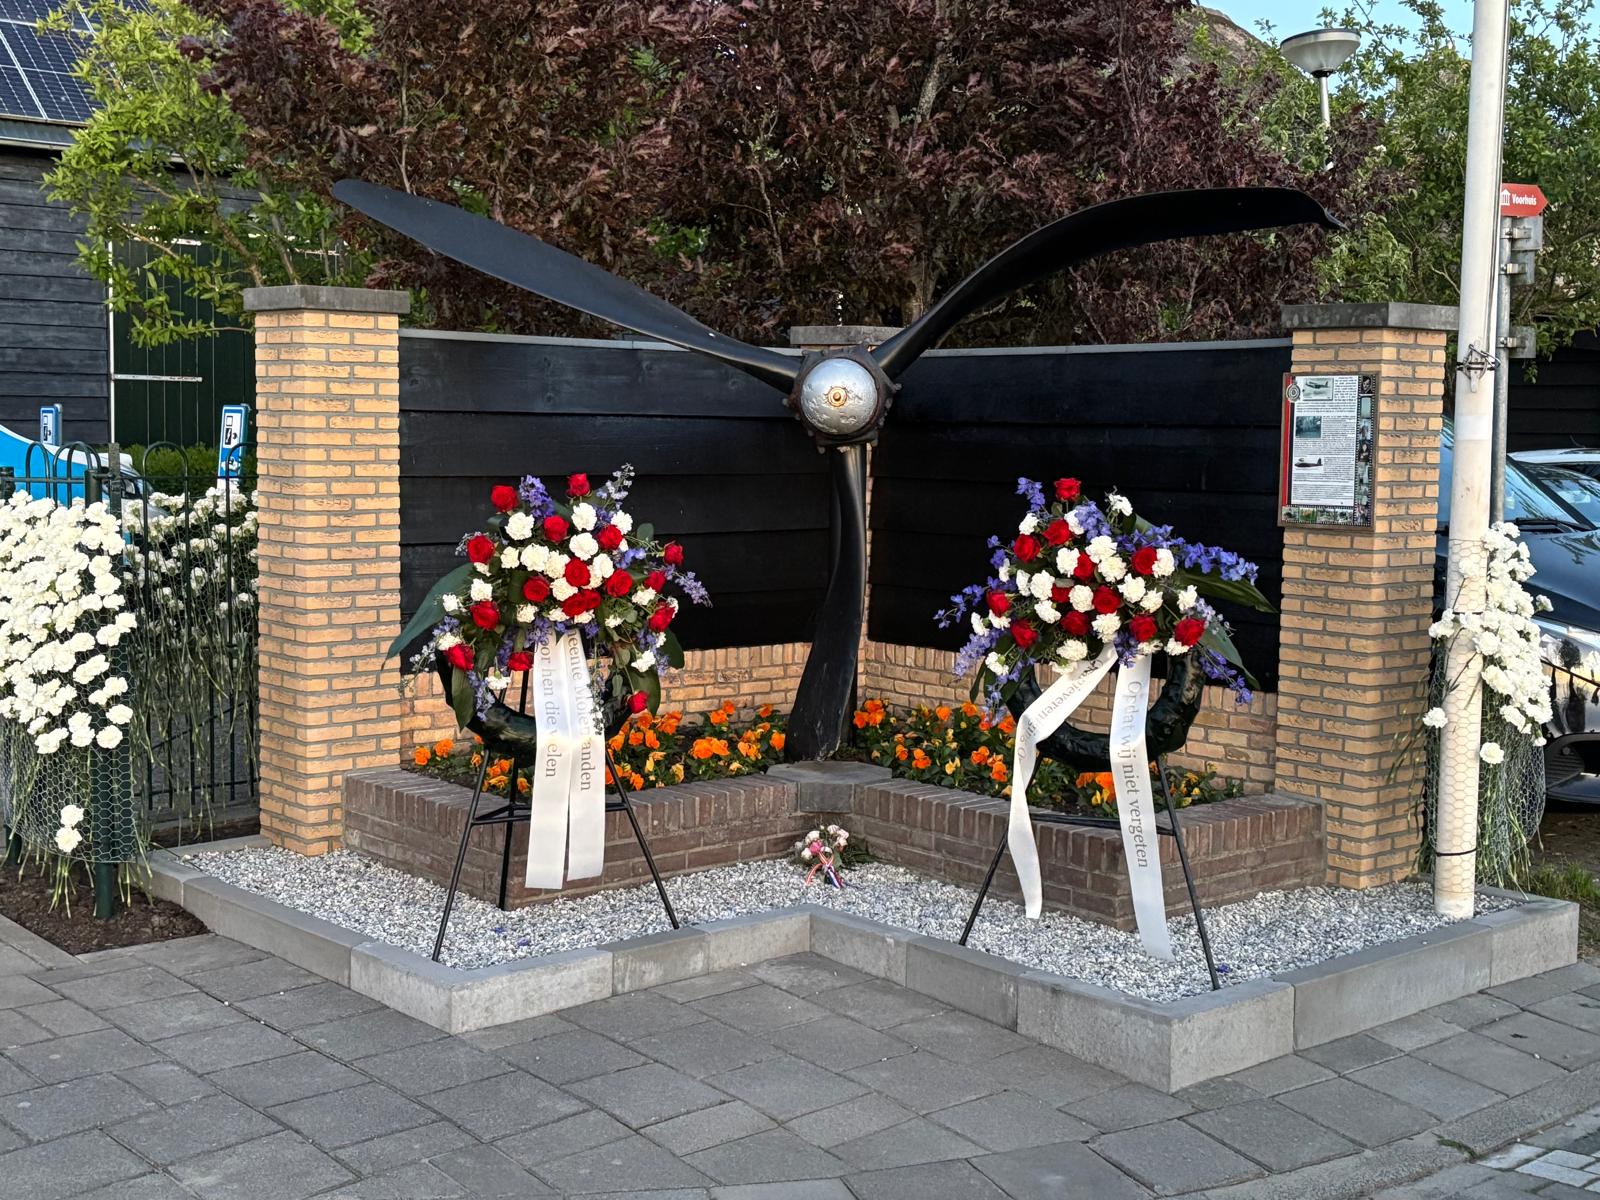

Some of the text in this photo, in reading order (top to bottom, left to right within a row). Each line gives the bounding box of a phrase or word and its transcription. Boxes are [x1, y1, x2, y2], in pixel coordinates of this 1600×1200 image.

[1511, 193, 1537, 206] Voorhuis
[542, 668, 557, 697] hen
[545, 700, 560, 725] die
[546, 728, 562, 778] velen
[1117, 680, 1149, 869] Opdat wij niet vergeten
